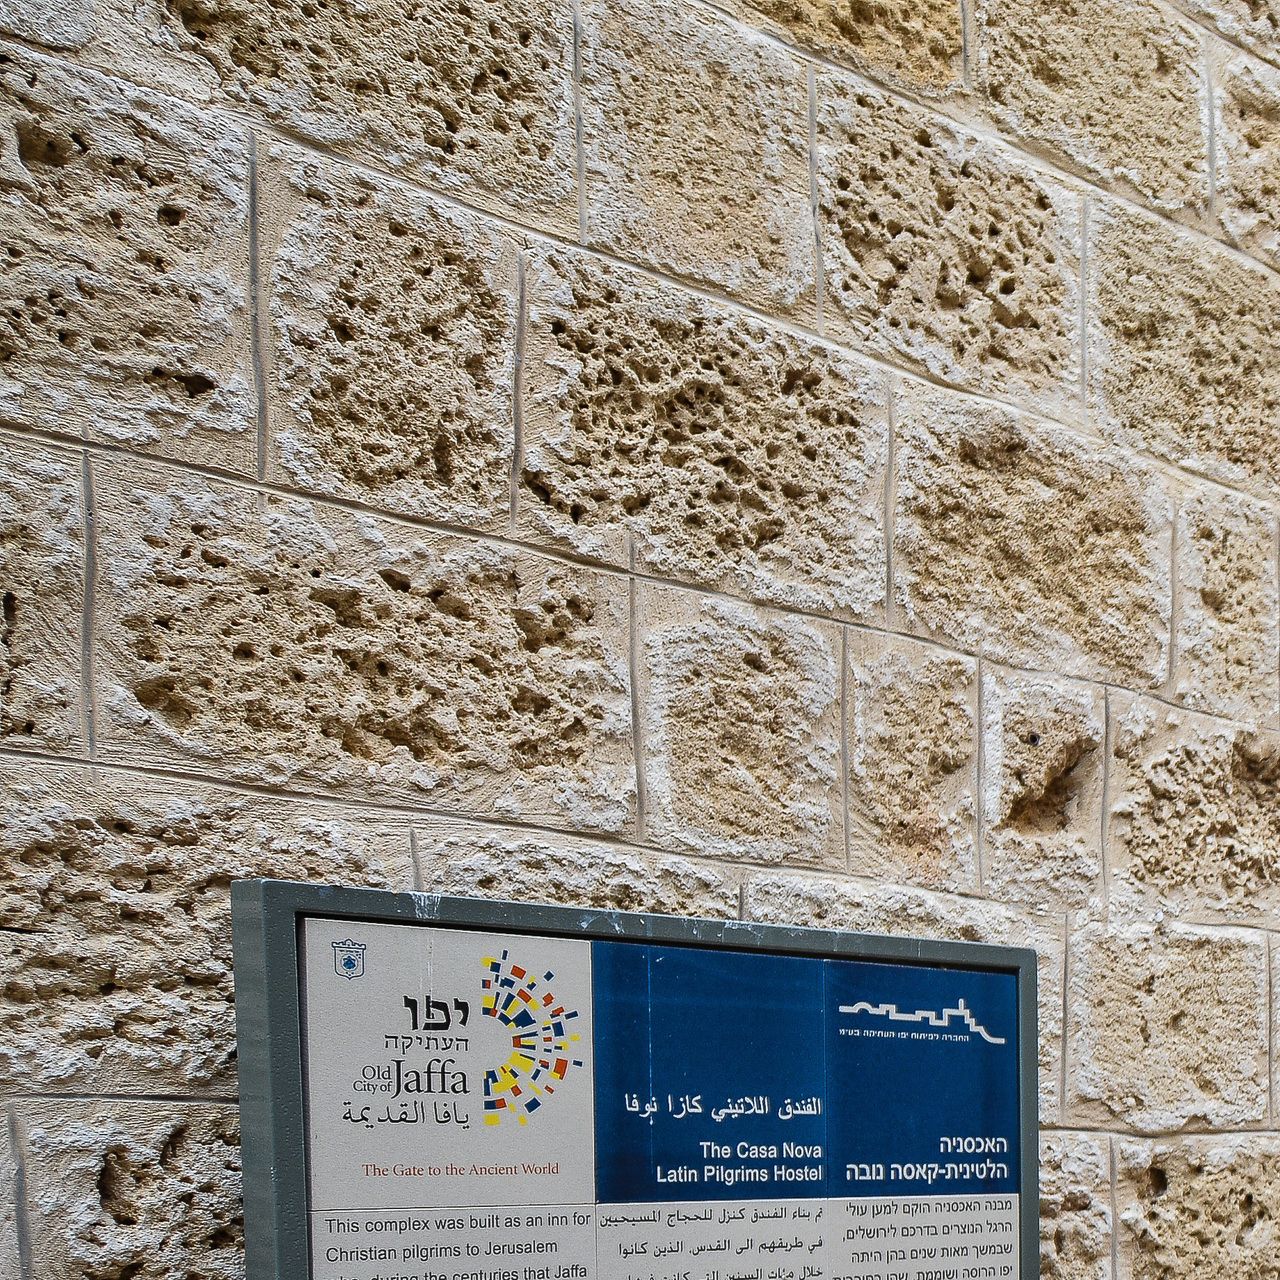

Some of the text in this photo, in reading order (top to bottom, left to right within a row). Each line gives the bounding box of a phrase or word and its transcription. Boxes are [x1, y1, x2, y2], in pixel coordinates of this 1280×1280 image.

[403, 994, 469, 1031] יפו
[384, 1034, 469, 1054] העתיקה
[361, 1065, 391, 1081] Old
[390, 1058, 470, 1099] Jaffa
[353, 1080, 392, 1096] City of
[342, 1100, 470, 1130] يافا القديمة
[625, 1093, 822, 1122] الفندق اللاتيني كازا نوفا
[699, 1142, 824, 1158] The Casa Nova
[940, 1136, 1008, 1153] האכסניה
[362, 1162, 558, 1176] The Gate to the Ancient World
[657, 1165, 824, 1186] Latin Pilgrims Hostel
[846, 1159, 1009, 1184] הלטינית-קאסה נובה
[600, 1207, 822, 1227] تم بناء الفندق كنزل للحجاج المسيحيين
[846, 1201, 1011, 1219] מבנה האכסניה הוקם למען עולי
[325, 1212, 591, 1234] This complex was built as an inn for
[326, 1240, 557, 1262] Christian pilgrims to Jerusalem
[852, 1244, 1012, 1264] שבמשך מאות שנים בהן היתה
[524, 1267, 551, 1280] that
[554, 1264, 586, 1278] Jaffa
[799, 1265, 823, 1280] خلال
